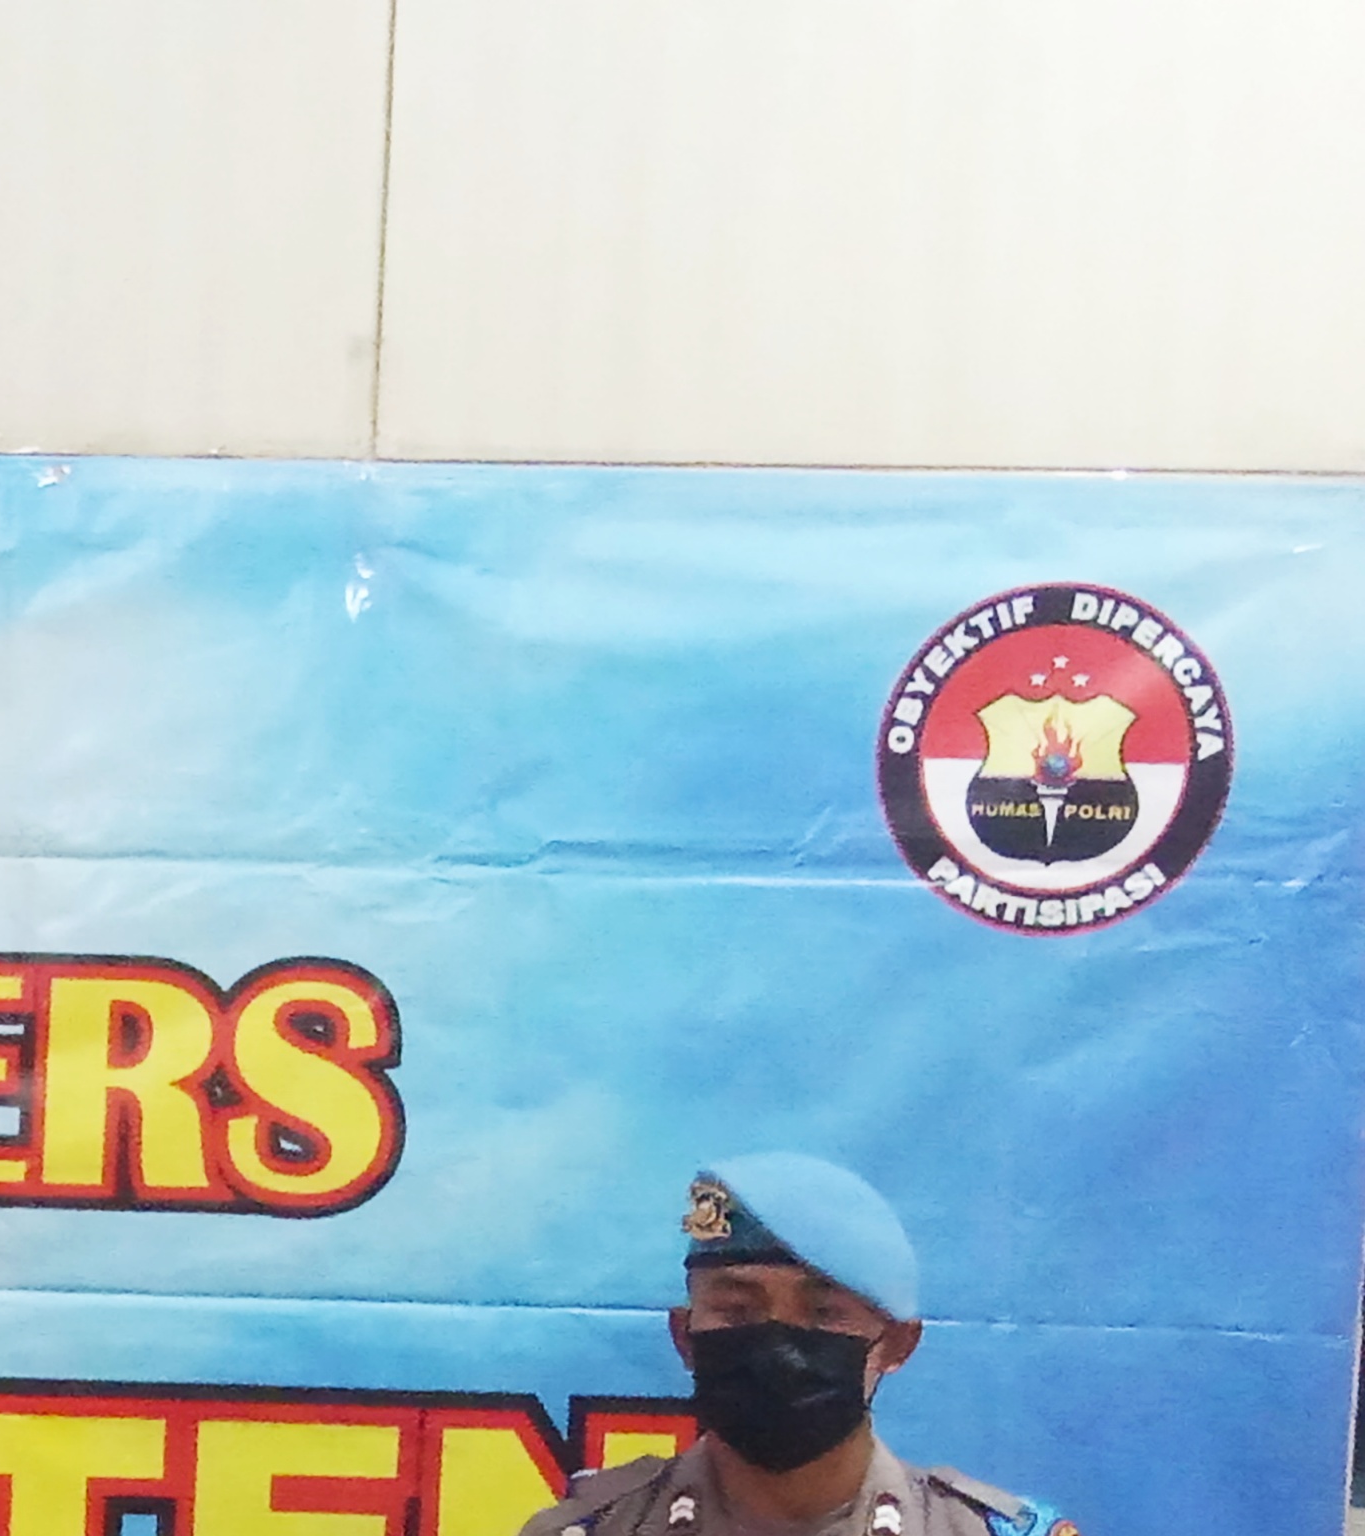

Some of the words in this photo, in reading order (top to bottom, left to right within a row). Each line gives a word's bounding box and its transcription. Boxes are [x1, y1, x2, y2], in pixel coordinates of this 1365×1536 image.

[887, 595, 1035, 754] OBYEKTIF
[1070, 592, 1225, 761] DIPERCAYA
[1064, 804, 1131, 821] POLRI
[927, 857, 1167, 927] PARTISIPASI
